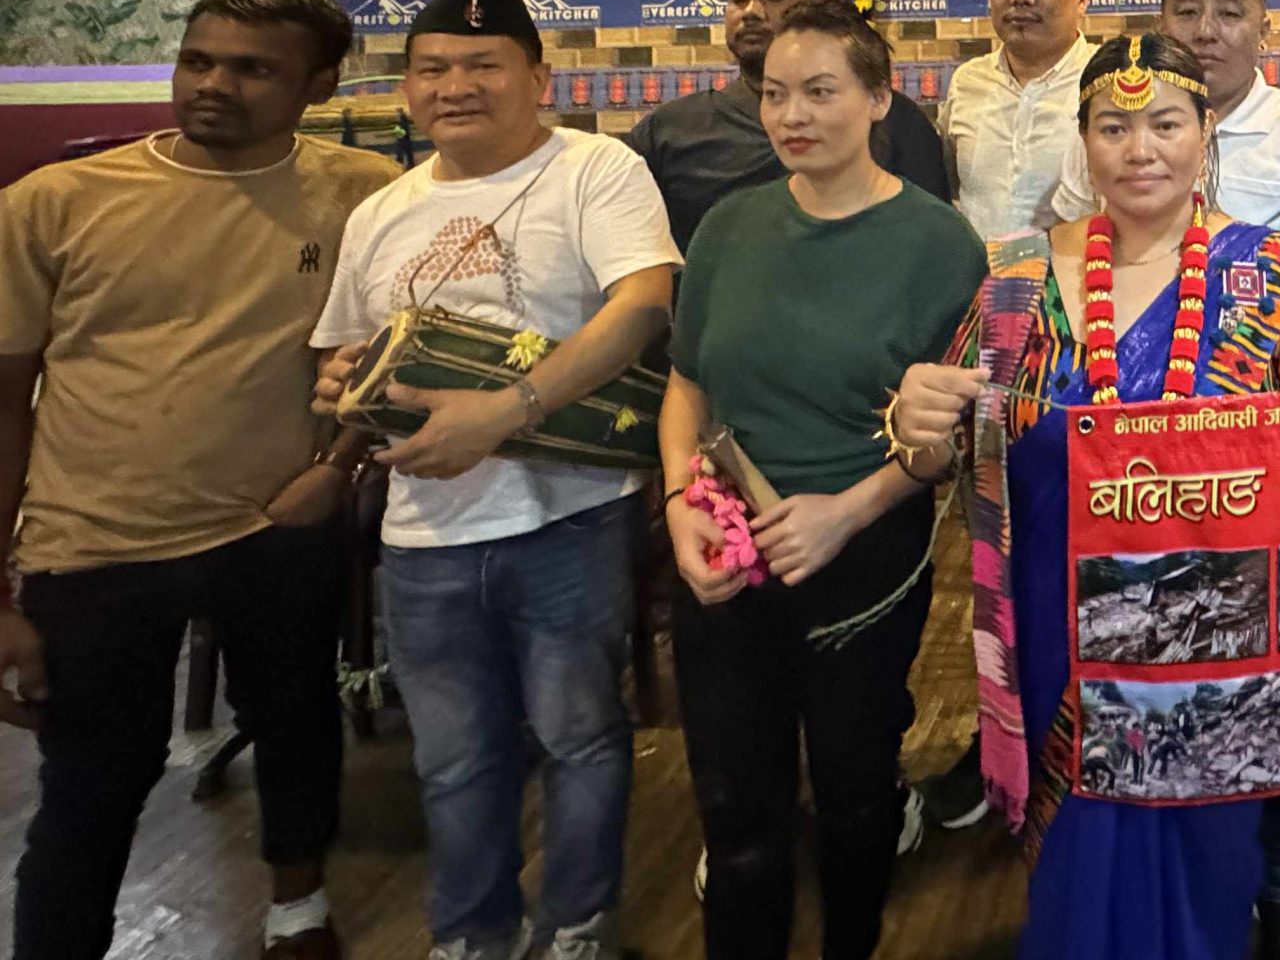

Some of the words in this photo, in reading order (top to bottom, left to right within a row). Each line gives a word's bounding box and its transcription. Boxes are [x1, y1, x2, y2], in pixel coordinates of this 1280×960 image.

[538, 8, 599, 21] KITCHEN
[889, 0, 947, 12] KITCHEN
[1114, 413, 1168, 435] नेपाल
[1174, 407, 1258, 432] आदिवासी
[1088, 456, 1267, 524] बलिहाङ
